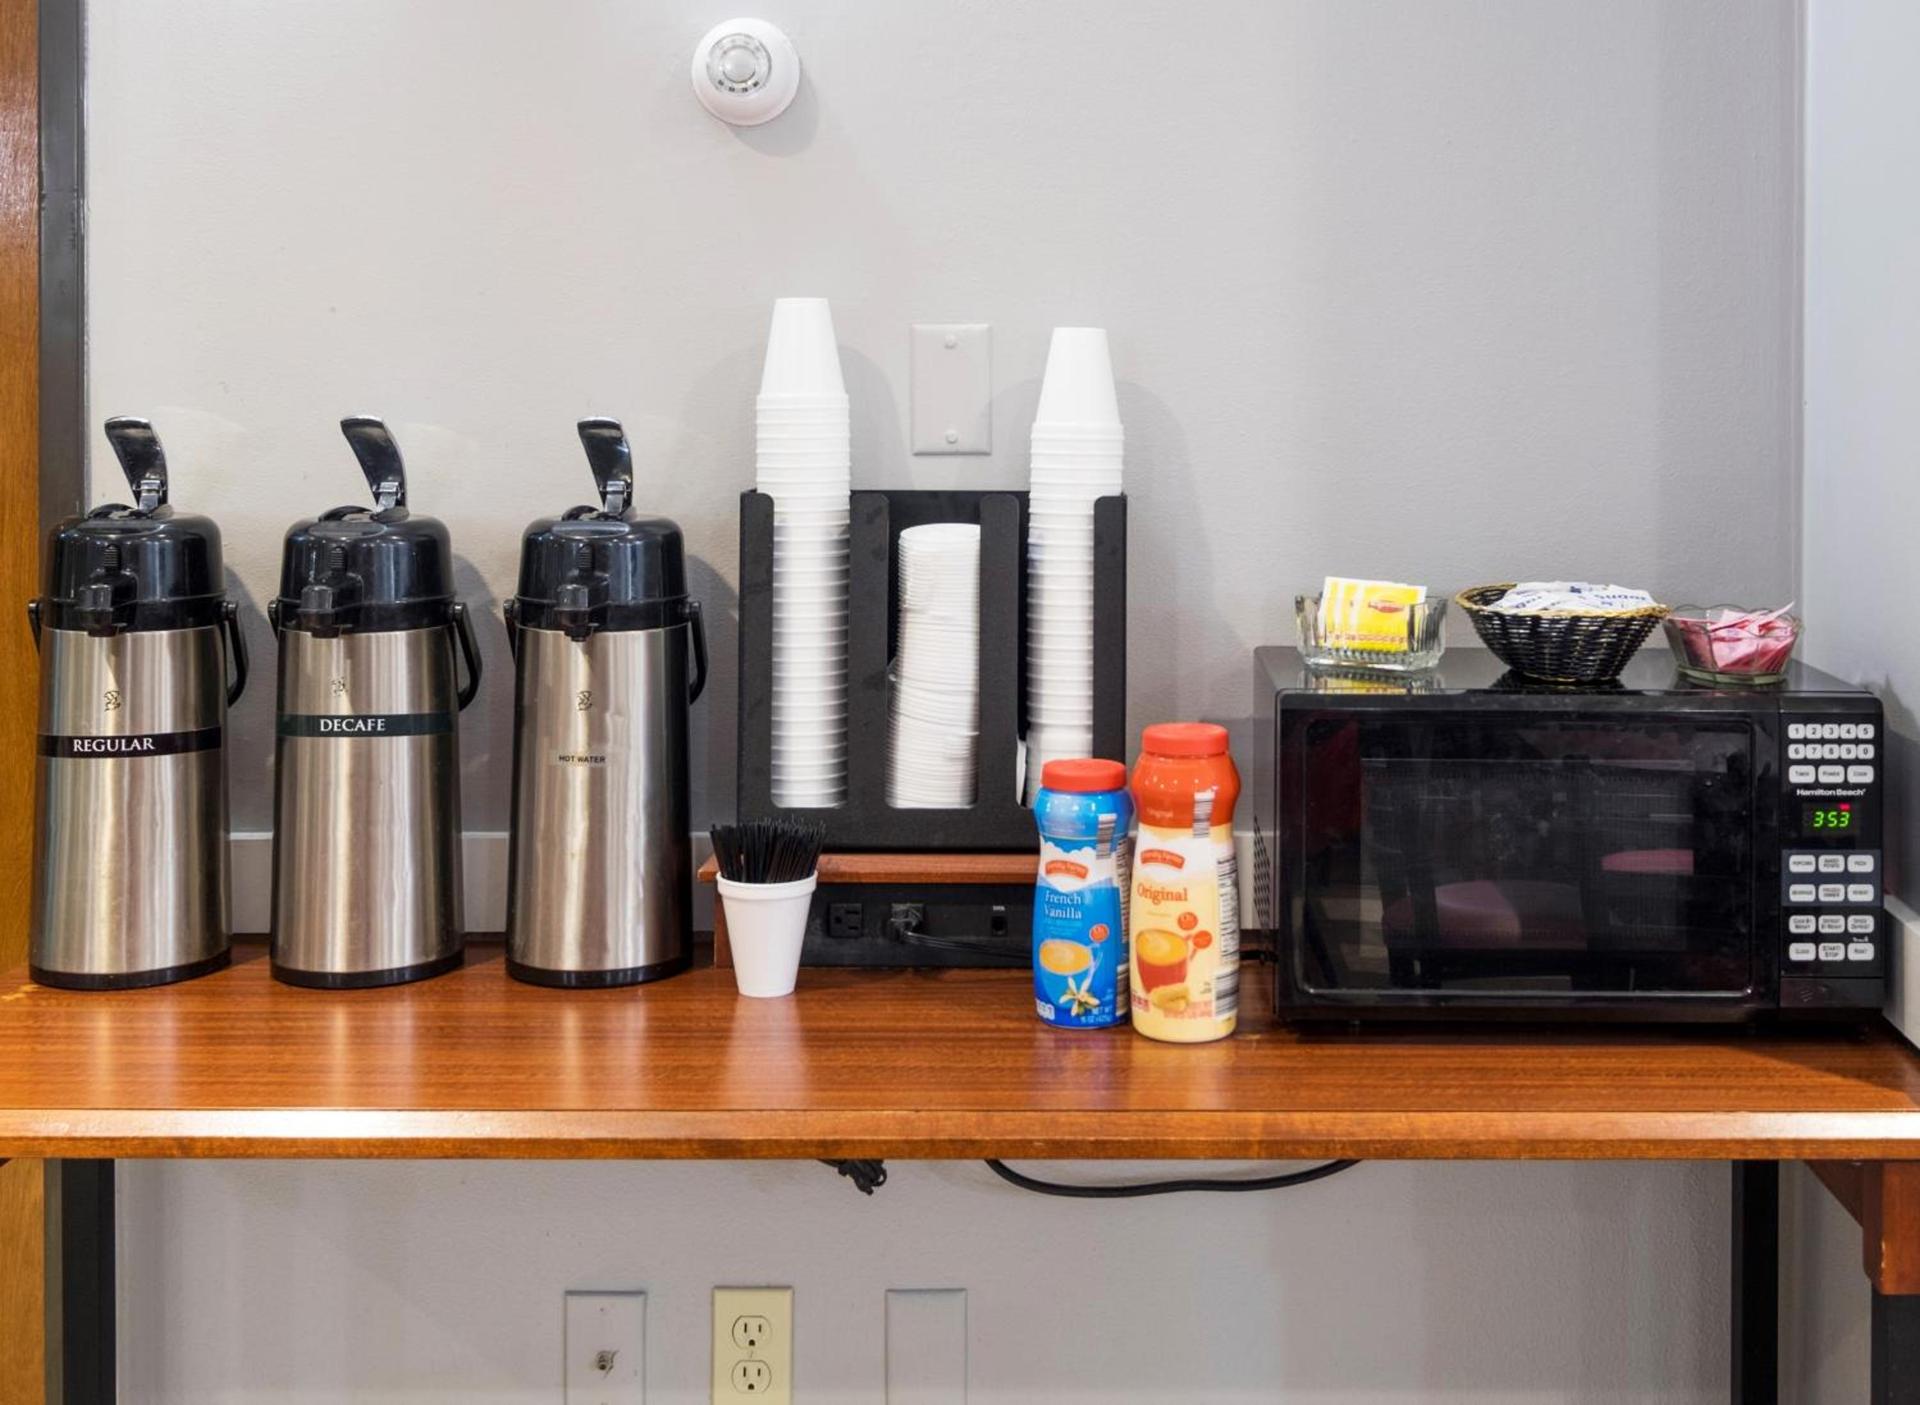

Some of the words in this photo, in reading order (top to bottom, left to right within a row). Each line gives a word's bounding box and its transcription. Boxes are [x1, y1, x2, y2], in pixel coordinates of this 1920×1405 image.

[319, 718, 386, 732] DECAFE
[1811, 727, 1817, 736] 2
[1829, 727, 1834, 736] 3
[1846, 727, 1852, 735] 4
[1863, 727, 1869, 736] 5
[73, 737, 155, 752] REGULAR
[559, 755, 575, 763] HOT
[577, 755, 606, 764] WATER
[1796, 788, 1836, 796] Hamilton
[1045, 890, 1082, 905] French
[1137, 882, 1188, 906] Original
[1044, 903, 1083, 919] Vanilla
